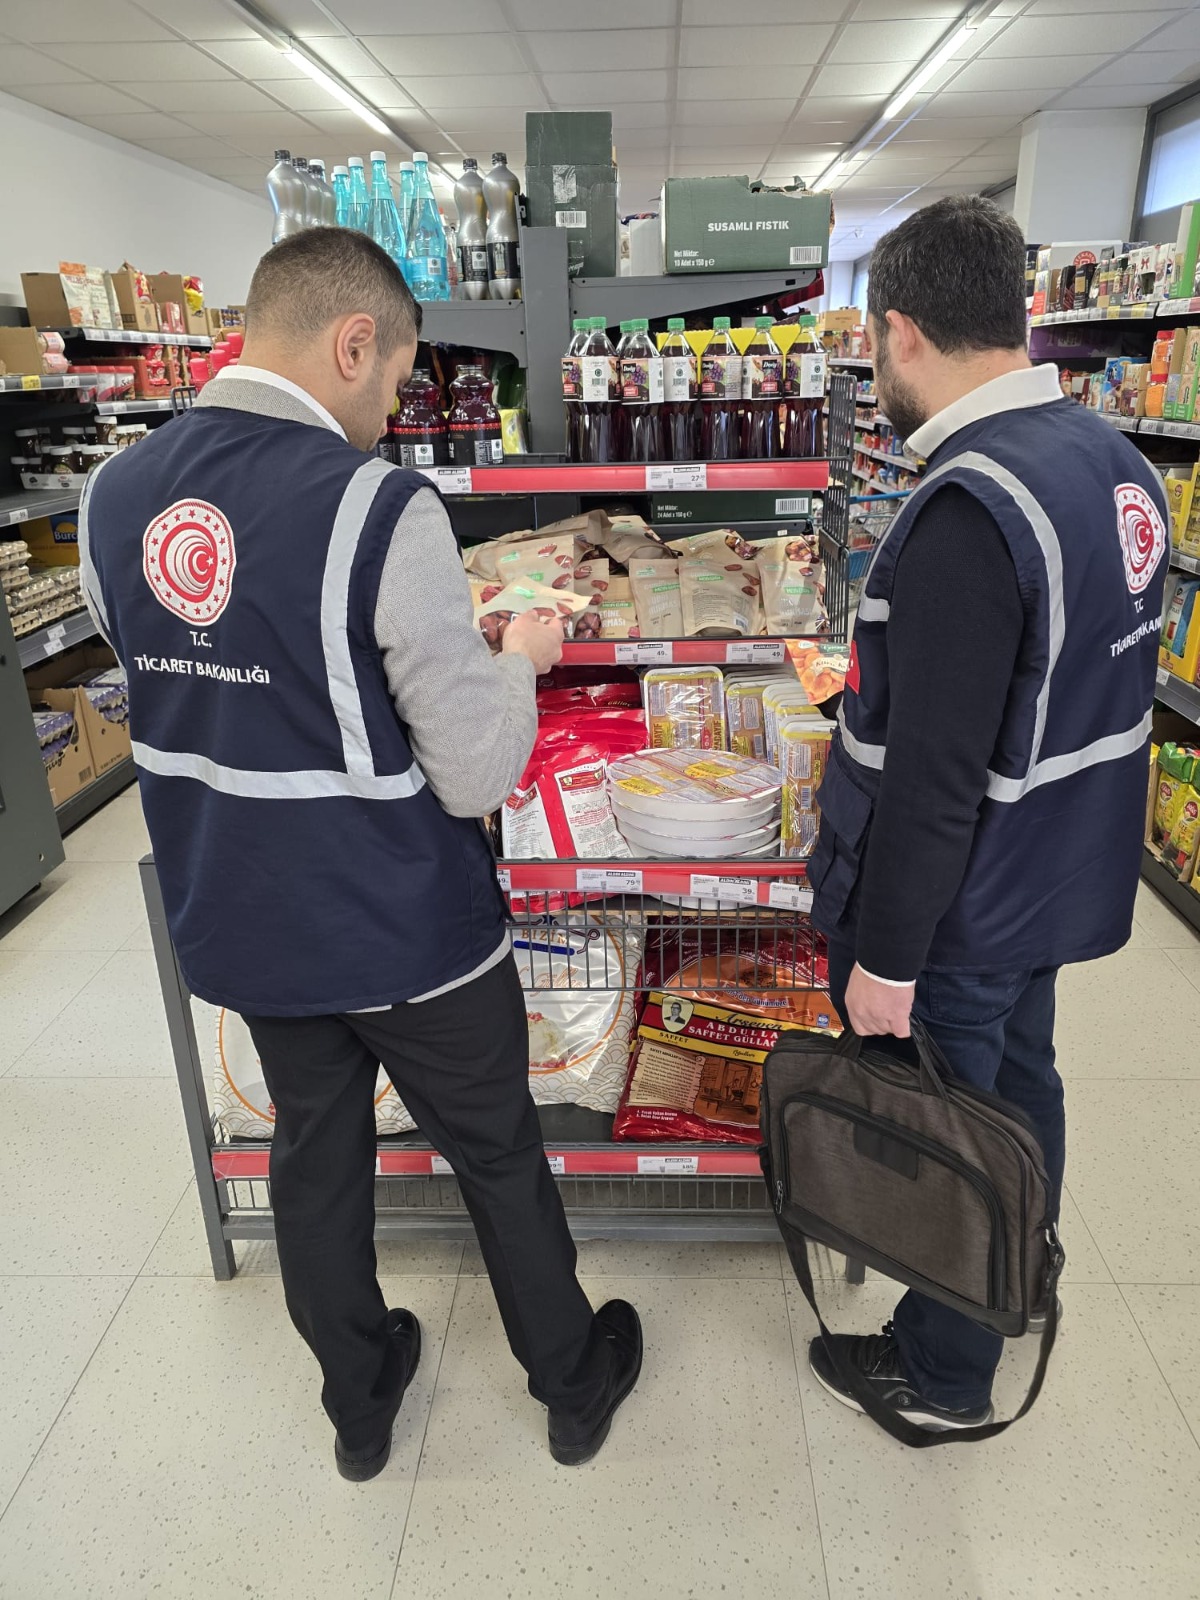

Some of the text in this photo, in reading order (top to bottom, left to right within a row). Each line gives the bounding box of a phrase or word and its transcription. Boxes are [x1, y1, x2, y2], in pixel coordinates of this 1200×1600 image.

[707, 220, 790, 232] SUSAMLI FISTIK
[190, 631, 212, 647] T.C.
[134, 654, 270, 684] TİCARET BAKANLIĞI
[654, 723, 663, 748] ADAYIF
[660, 1032, 689, 1043] SAFFET
[688, 1026, 730, 1040] SAFFET
[707, 1022, 778, 1039] ABDULLA
